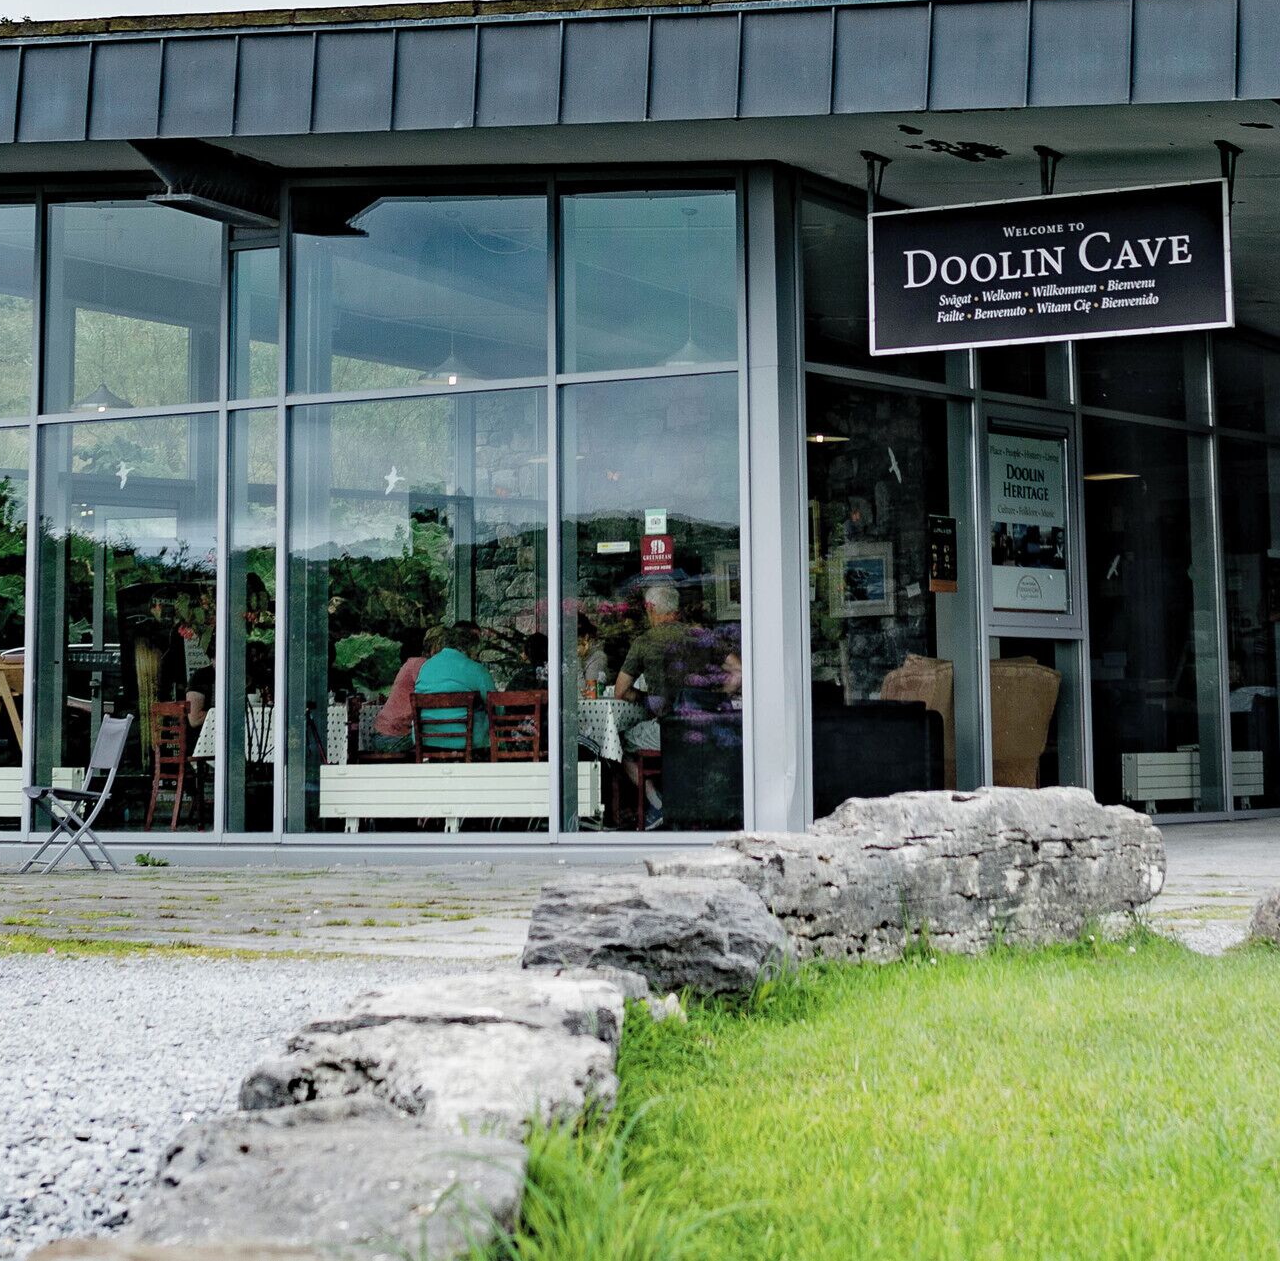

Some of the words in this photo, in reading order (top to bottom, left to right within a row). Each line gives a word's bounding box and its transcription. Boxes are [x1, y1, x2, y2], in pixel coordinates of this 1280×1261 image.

[903, 246, 1066, 289] DOOLIN
[1078, 231, 1193, 273] CAVE
[982, 288, 1022, 302] Welkom
[1032, 282, 1097, 298] Willkommen
[1107, 278, 1156, 292] Bienvenu
[937, 310, 966, 323] Failte
[974, 305, 1027, 321] Benvenuto
[1037, 300, 1072, 315] Witam
[1101, 292, 1160, 309] Bienvenido
[1006, 463, 1045, 483] DOOLIN
[1003, 481, 1049, 501] HERITAGE
